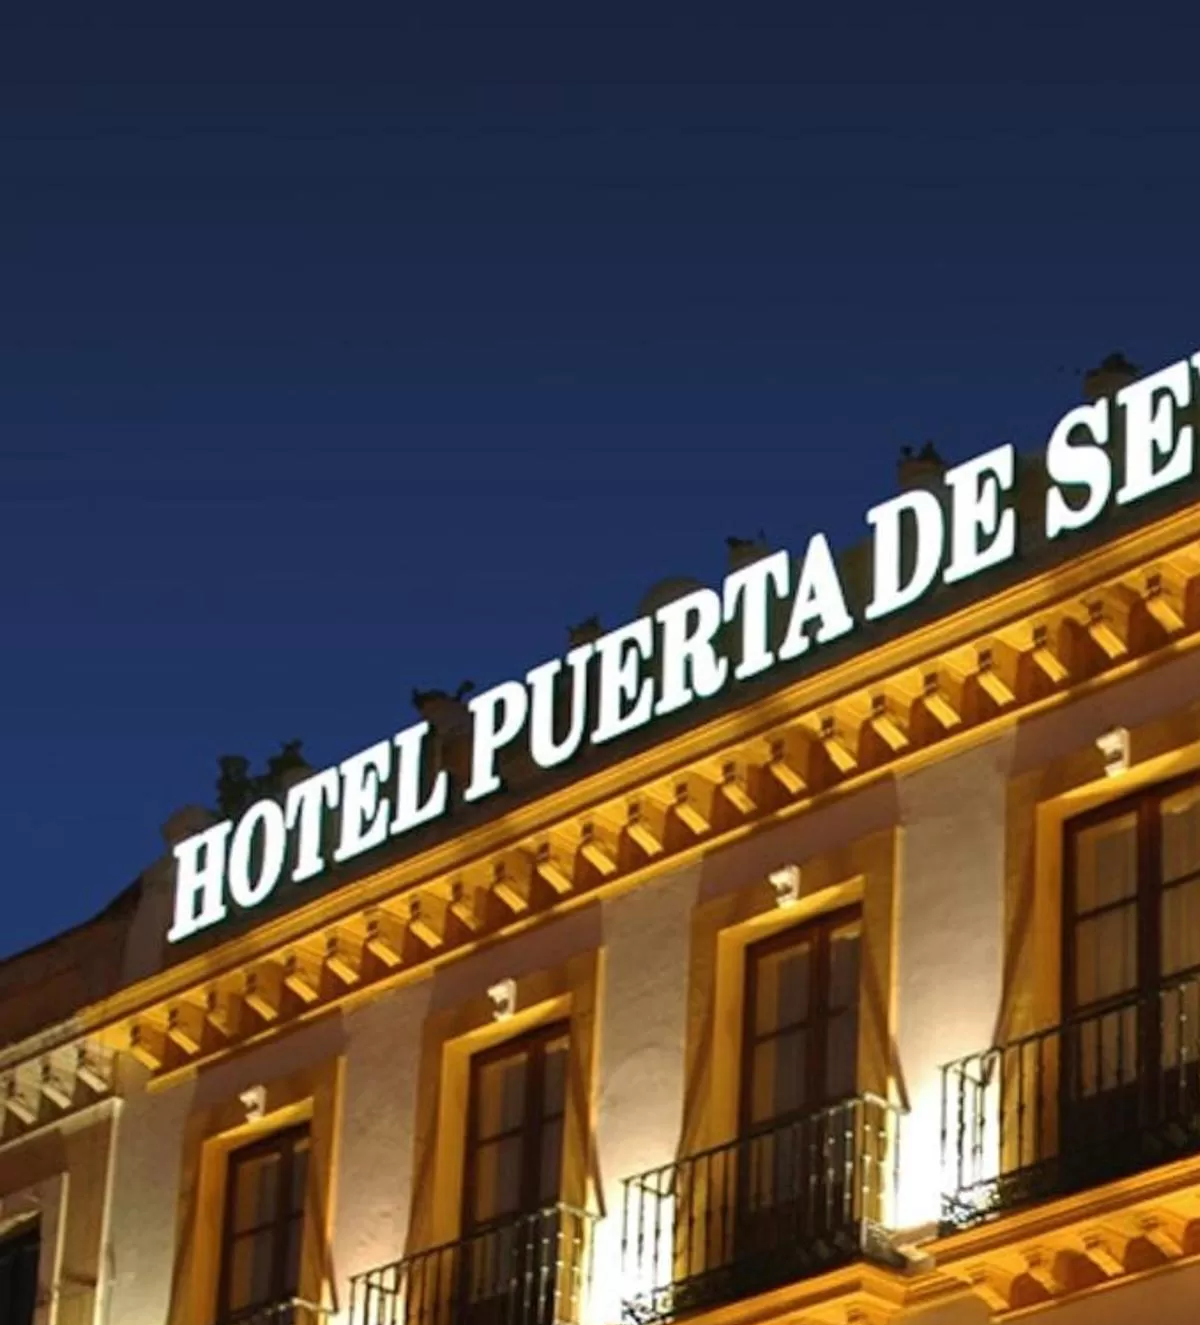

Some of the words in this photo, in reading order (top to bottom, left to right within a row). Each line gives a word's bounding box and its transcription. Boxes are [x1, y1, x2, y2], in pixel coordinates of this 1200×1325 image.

[167, 720, 447, 943] HOTEL
[464, 532, 853, 801] PUERTA
[865, 443, 1016, 620] DE
